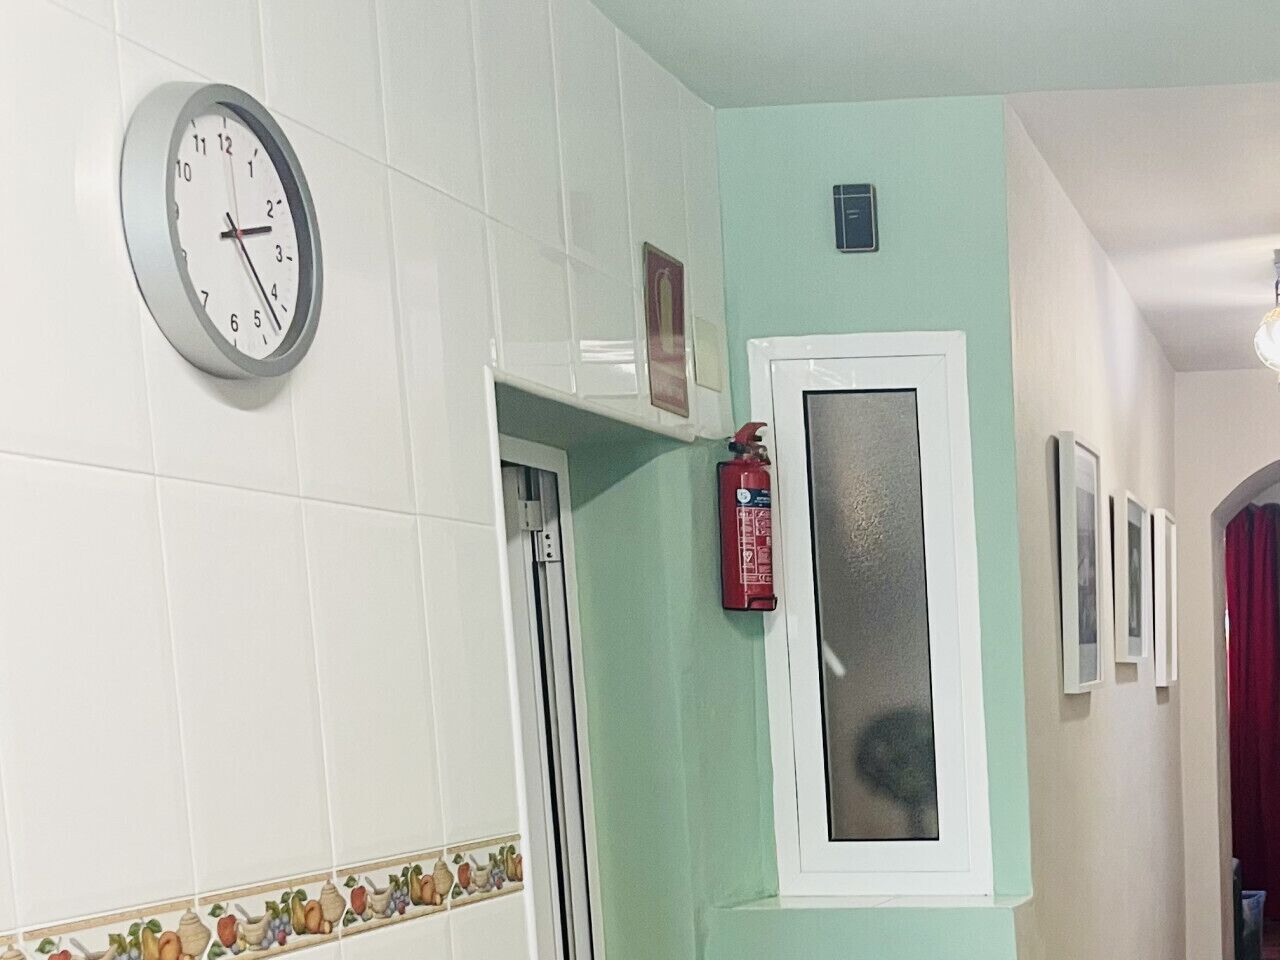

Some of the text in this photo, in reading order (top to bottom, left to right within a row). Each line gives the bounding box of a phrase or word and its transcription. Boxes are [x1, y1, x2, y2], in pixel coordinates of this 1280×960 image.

[193, 134, 206, 156] 11
[218, 133, 233, 156] 12
[176, 160, 192, 182] 10
[248, 160, 253, 178] 1
[266, 199, 274, 219] 2
[275, 244, 283, 263] 3
[201, 290, 209, 312] 7
[271, 283, 278, 301] 4
[230, 313, 239, 332] 6
[254, 310, 262, 328] 5
